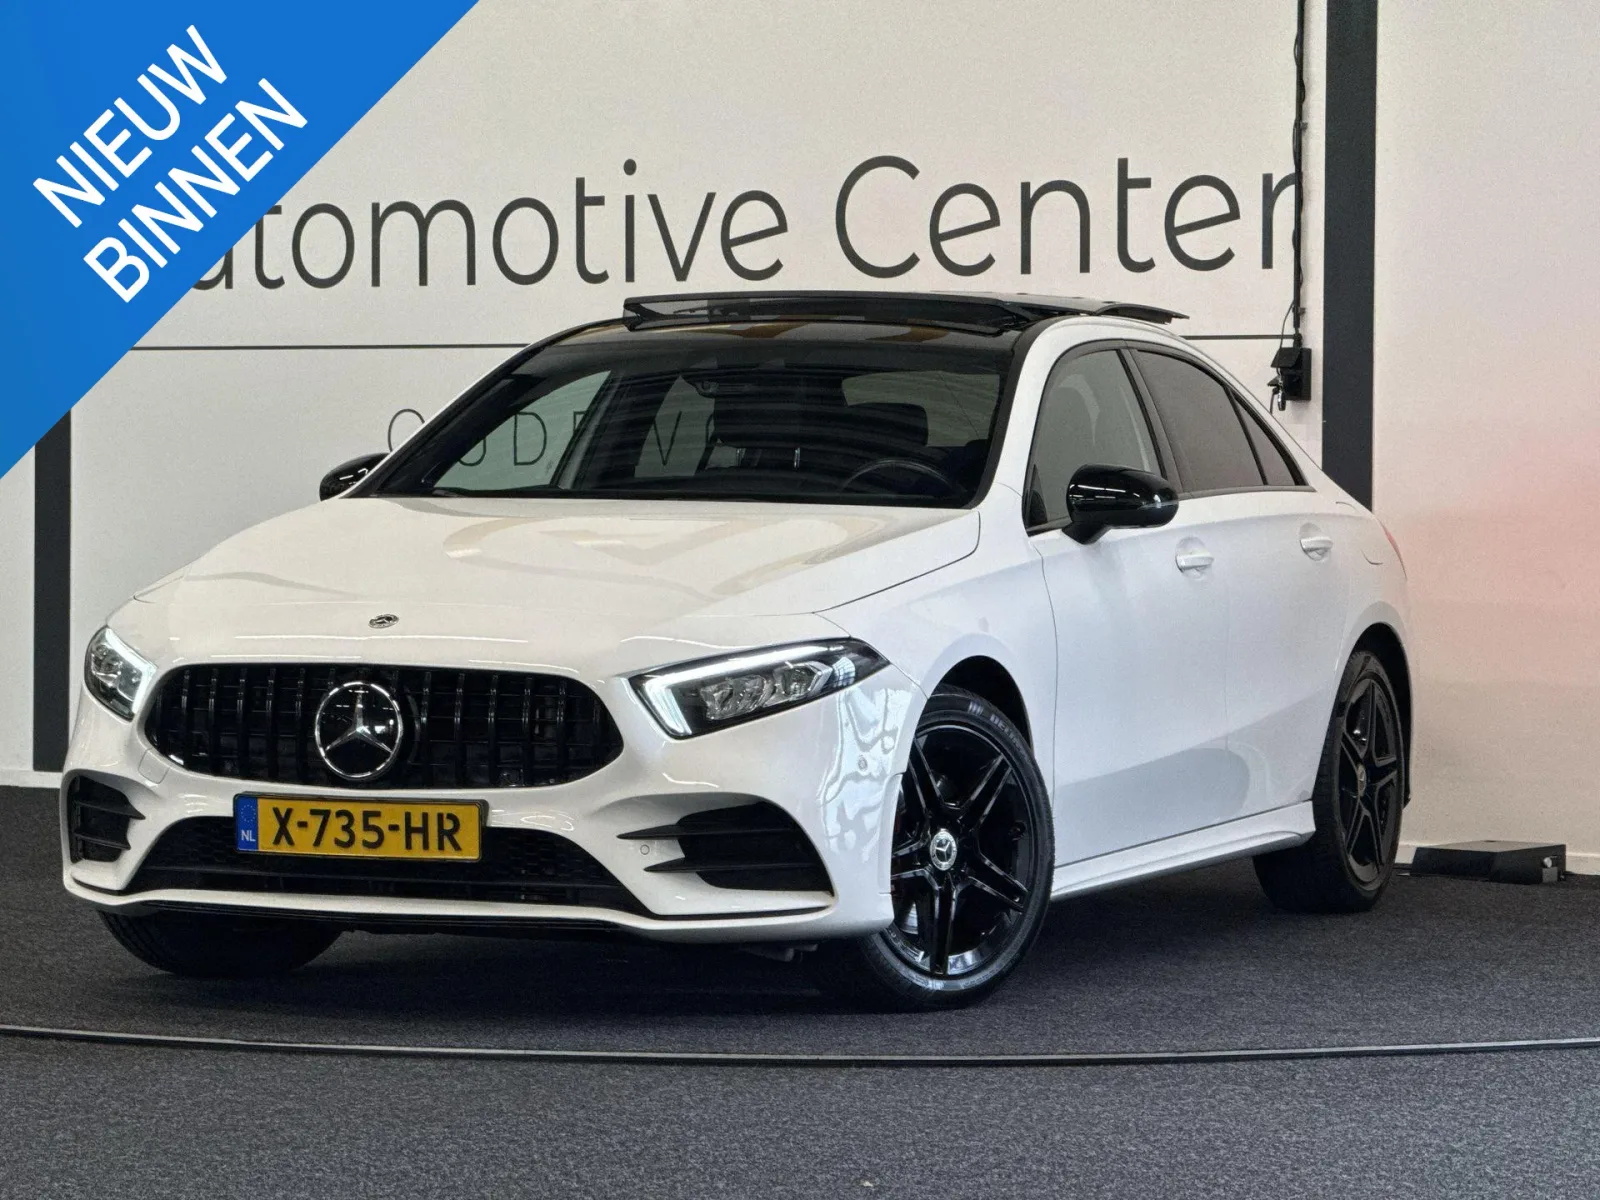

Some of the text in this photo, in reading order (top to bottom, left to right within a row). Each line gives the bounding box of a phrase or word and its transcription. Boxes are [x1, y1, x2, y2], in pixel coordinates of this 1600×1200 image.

[835, 154, 1300, 278] Center
[240, 829, 256, 842] NL
[272, 806, 462, 851] X-735-HR
